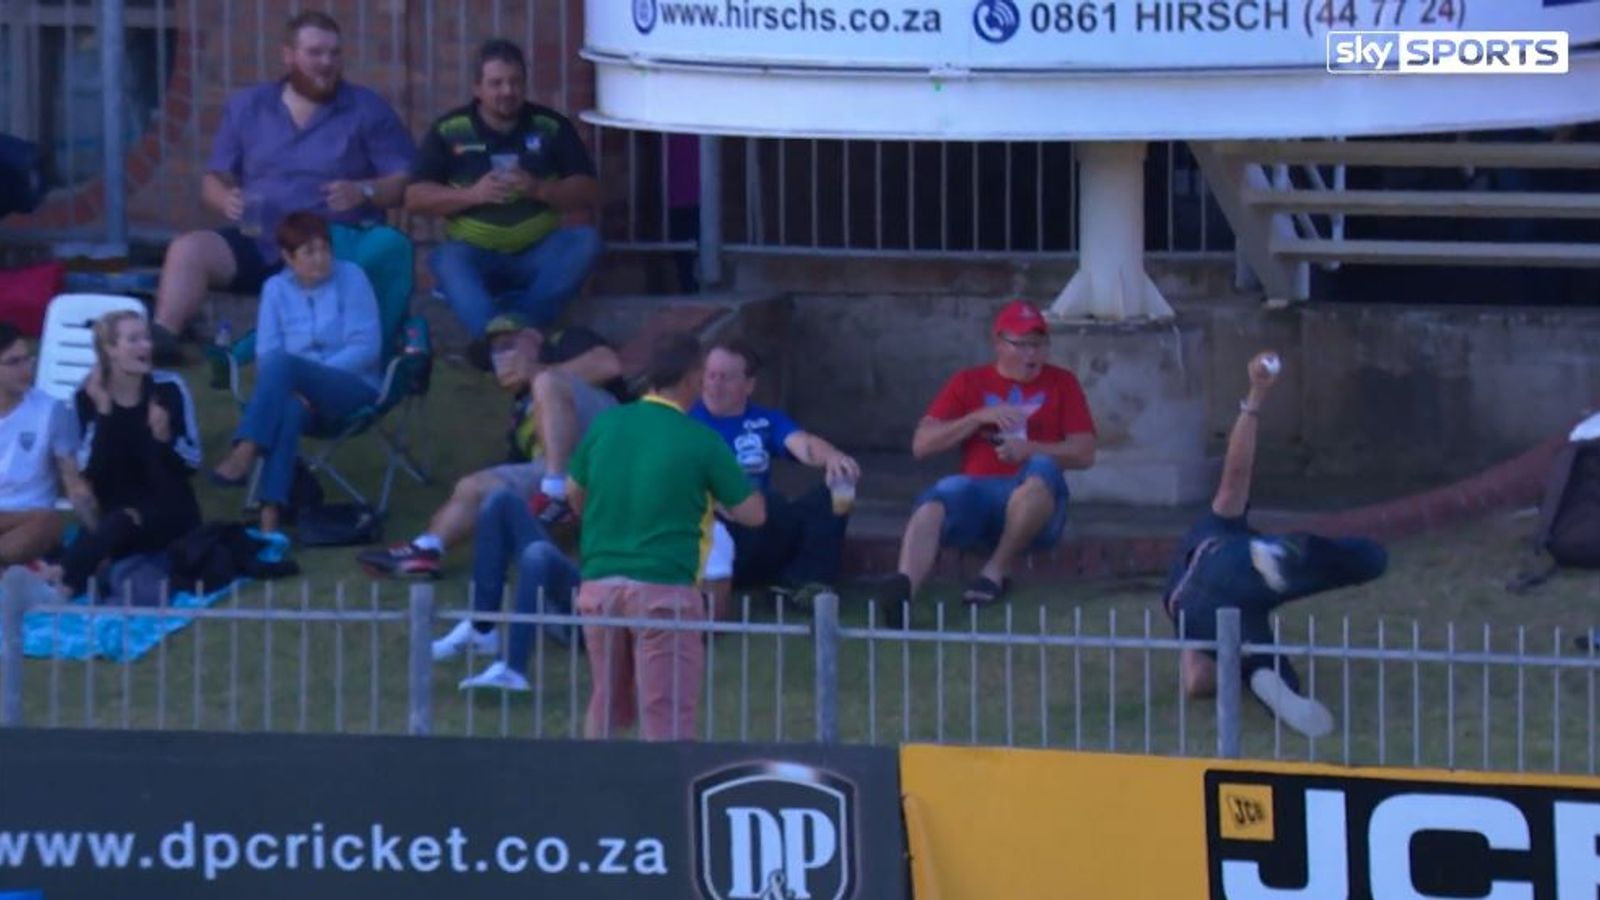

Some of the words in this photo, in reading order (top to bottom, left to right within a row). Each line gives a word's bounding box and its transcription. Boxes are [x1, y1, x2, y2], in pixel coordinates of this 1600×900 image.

[660, 0, 942, 33] www.hirschs.co.za
[1030, 2, 1117, 33] 0861
[1135, 0, 1289, 32] HIRSCH
[1373, 0, 1401, 27] 77
[0, 822, 668, 880] www.dpcricket.co.za
